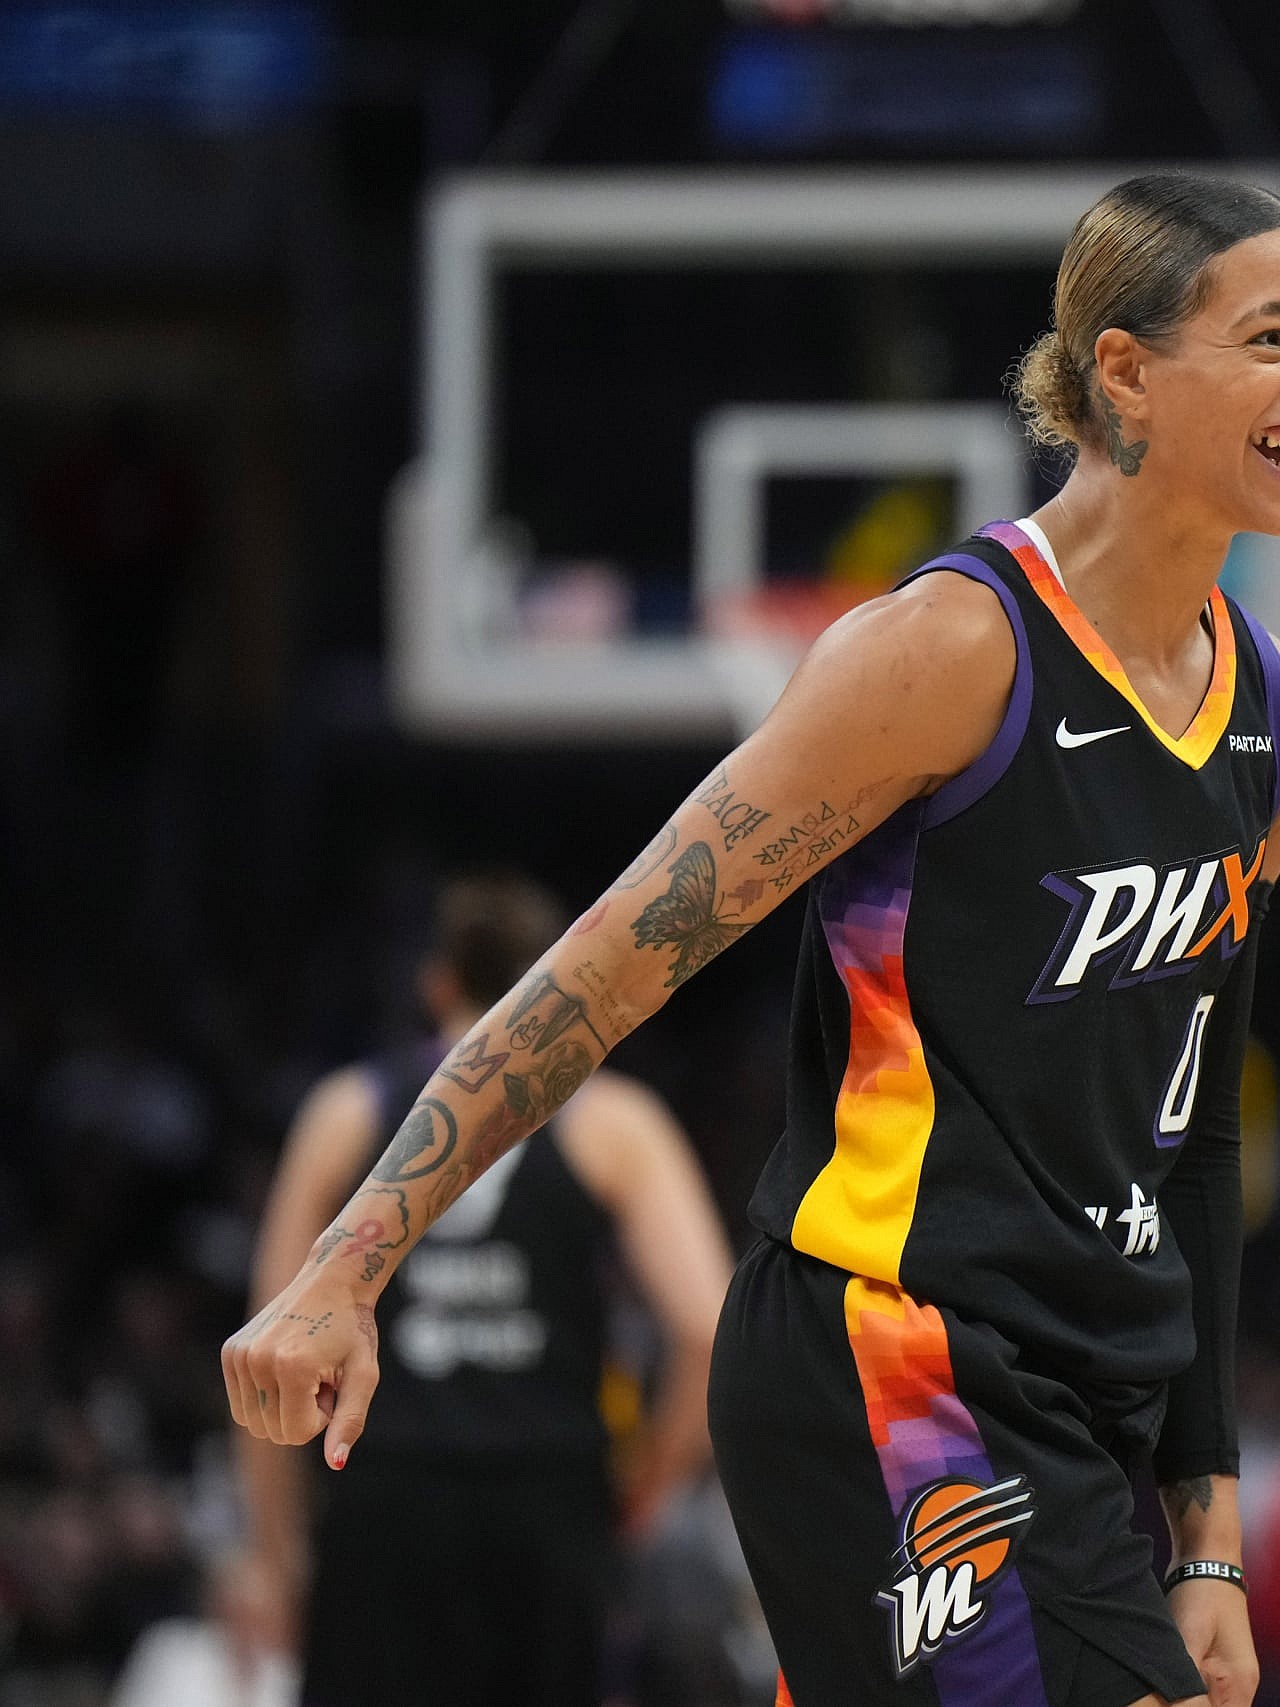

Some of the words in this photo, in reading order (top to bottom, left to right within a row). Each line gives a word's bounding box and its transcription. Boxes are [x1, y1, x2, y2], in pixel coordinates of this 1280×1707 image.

[752, 801, 836, 866] POWER
[1052, 838, 1267, 988] PHX
[1183, 1561, 1230, 1578] FREE
